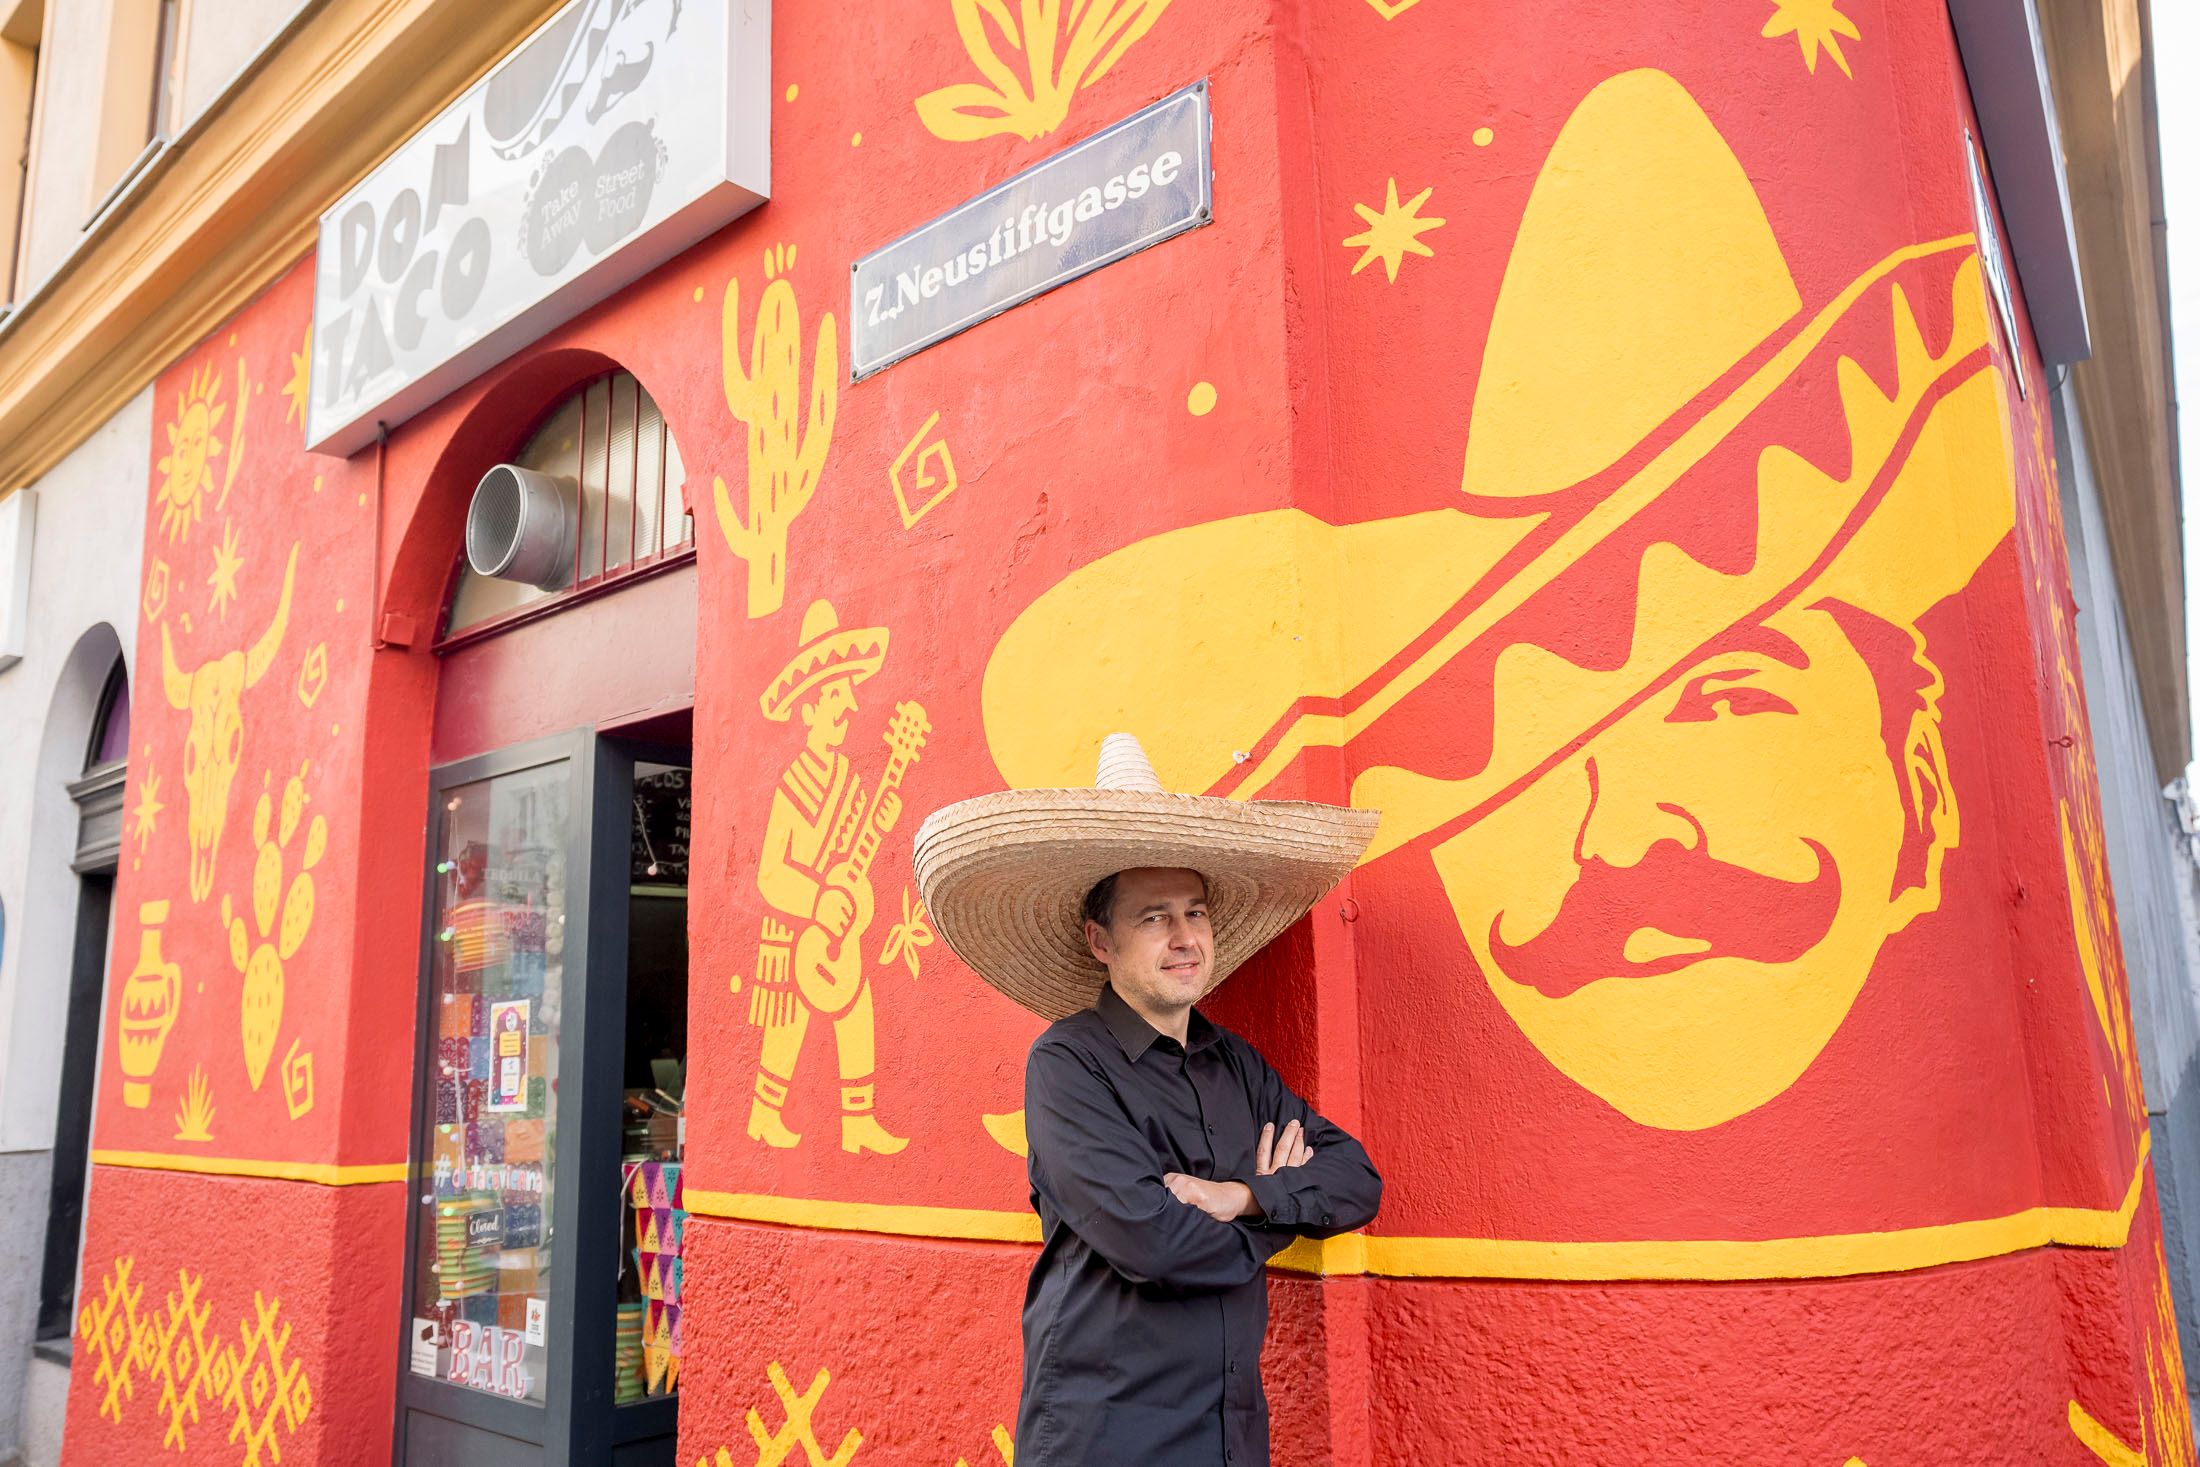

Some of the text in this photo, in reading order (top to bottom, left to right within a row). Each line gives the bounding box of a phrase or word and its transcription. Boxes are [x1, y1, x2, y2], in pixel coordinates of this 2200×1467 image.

[541, 181, 580, 225] Take
[594, 160, 646, 199] Street
[340, 113, 470, 302] DON
[541, 202, 580, 250] Away
[598, 187, 636, 222] Food
[892, 150, 1183, 312] Neustiftgasse
[322, 216, 491, 410] TACO
[469, 1214, 499, 1236] Closed
[447, 1319, 527, 1400] BAR
